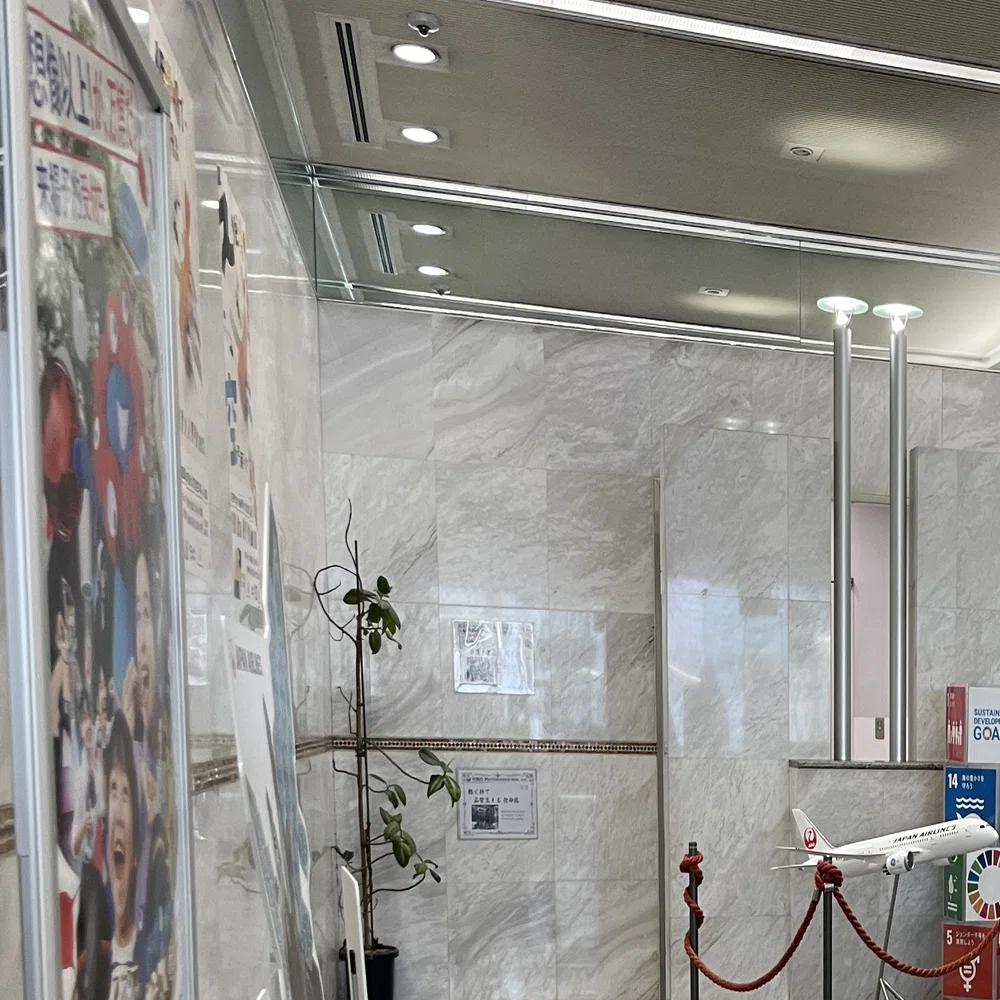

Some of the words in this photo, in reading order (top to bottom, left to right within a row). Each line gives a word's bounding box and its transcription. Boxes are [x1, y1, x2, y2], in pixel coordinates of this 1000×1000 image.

[948, 773, 958, 789] 14
[892, 833, 918, 844] JAPAN
[919, 824, 957, 838] AIRLINES
[947, 929, 953, 945] 5
